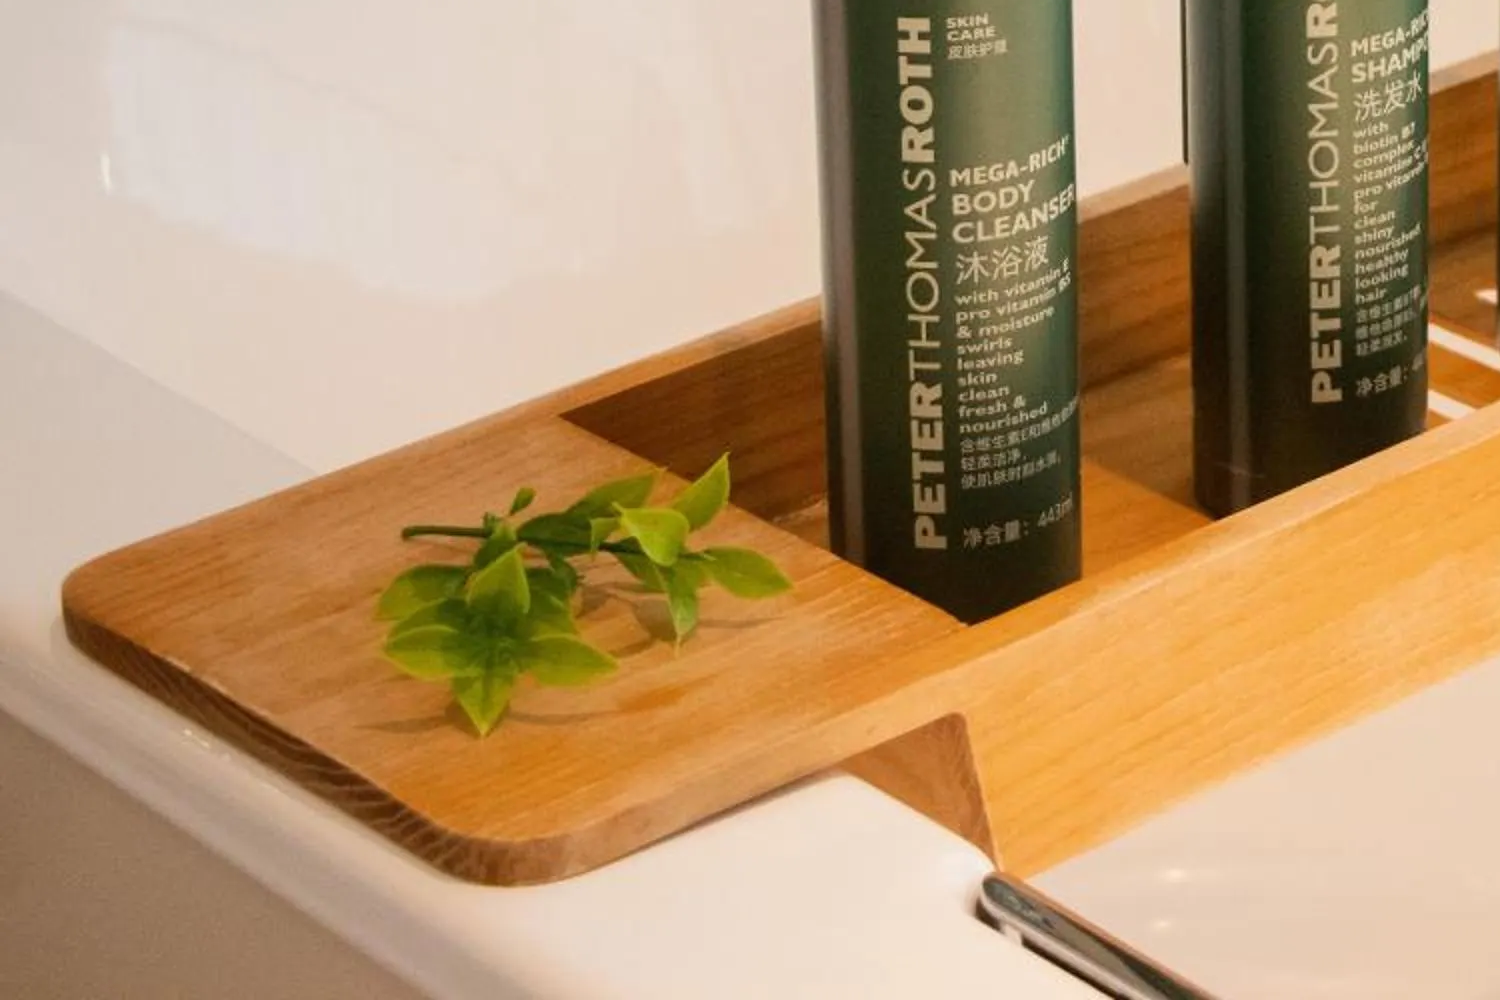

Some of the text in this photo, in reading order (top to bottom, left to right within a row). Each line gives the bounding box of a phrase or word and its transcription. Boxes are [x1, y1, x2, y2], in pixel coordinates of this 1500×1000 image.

[947, 12, 989, 29] SKIN
[947, 26, 996, 41] CARE
[1353, 70, 1422, 122] 洗发水
[952, 179, 1035, 216] BODY
[952, 183, 1075, 244] CLEANSER
[1354, 210, 1395, 230] clean
[955, 235, 1049, 285] 沐浴液
[954, 288, 999, 306] with
[1355, 288, 1387, 304] hair
[956, 309, 991, 325] pro
[956, 305, 1055, 339] & moisture
[957, 336, 1013, 355] swirls
[957, 349, 1025, 371] leaving
[957, 371, 998, 387] skin
[958, 386, 1010, 402] clean
[958, 401, 1008, 418] fresh
[960, 401, 1048, 433] nourished
